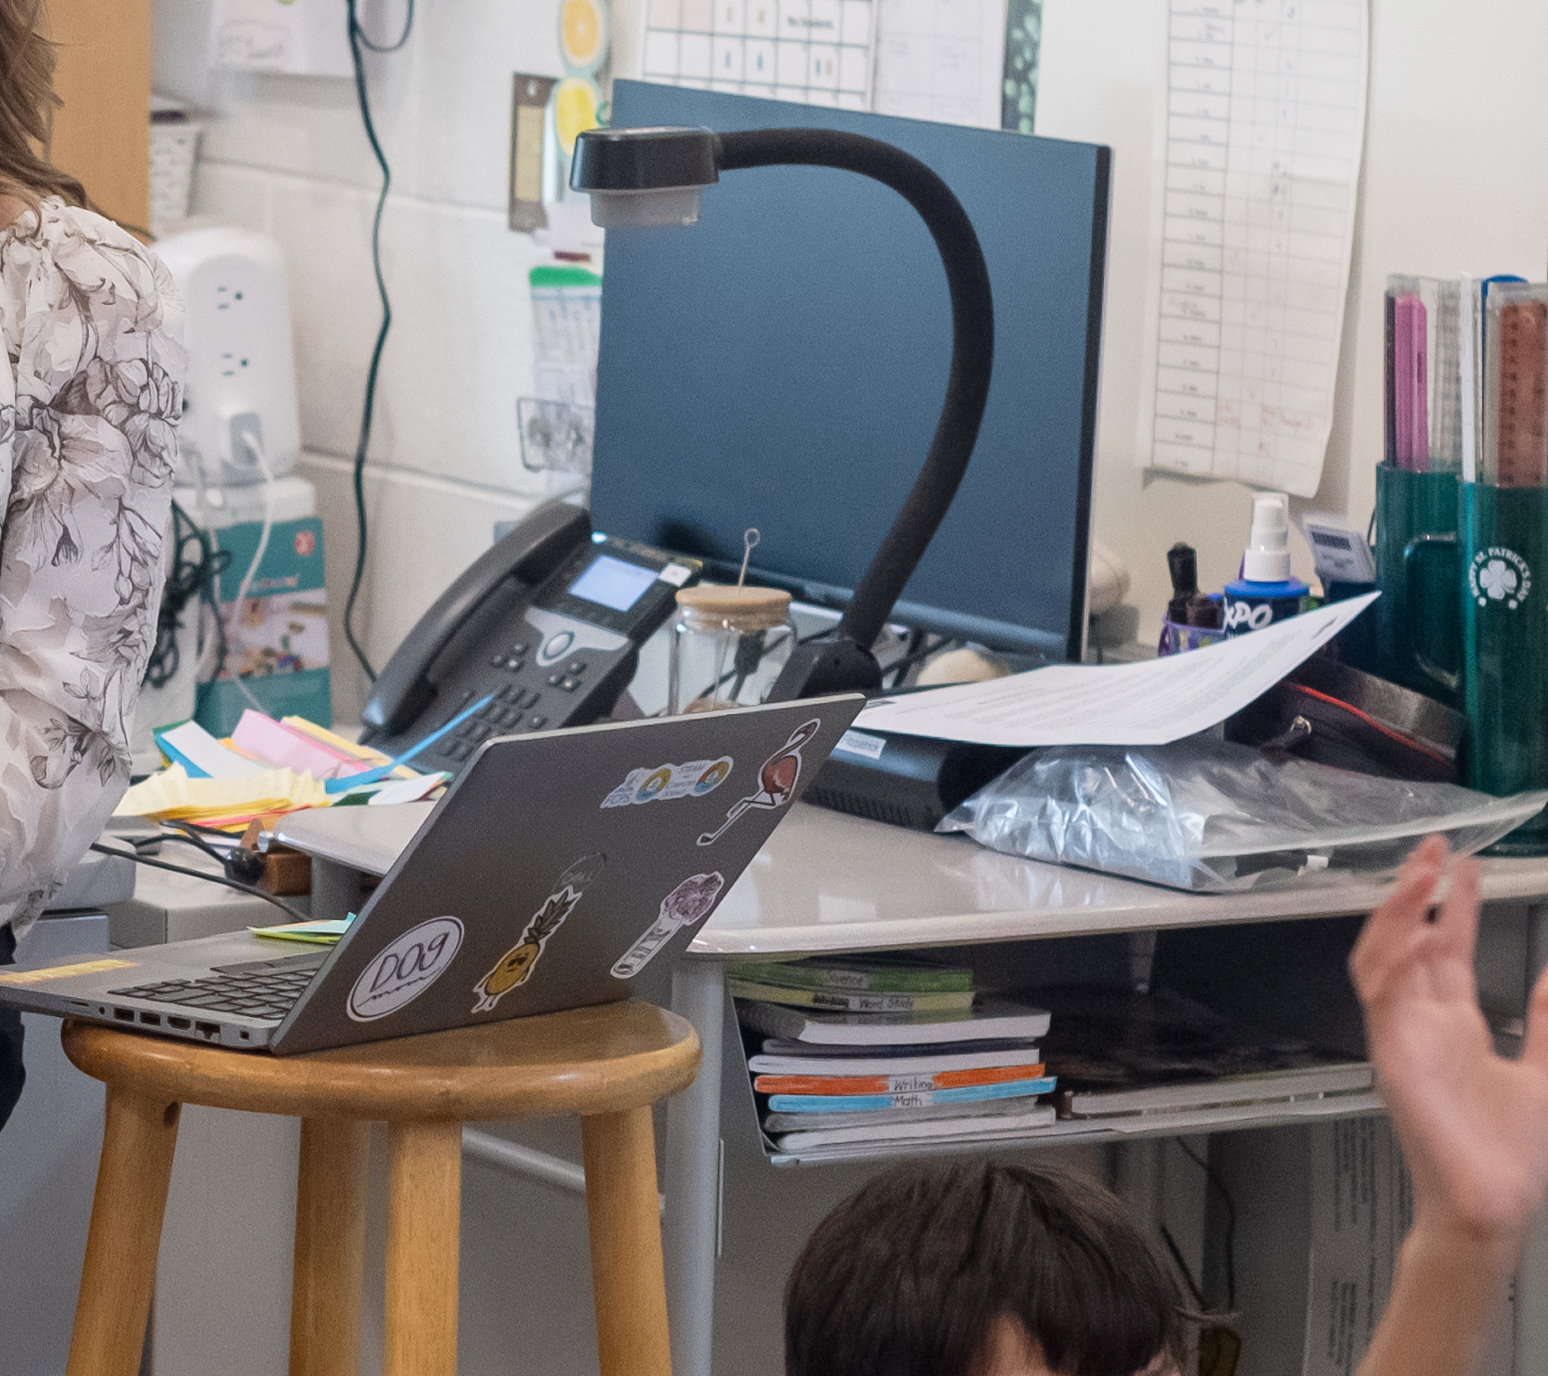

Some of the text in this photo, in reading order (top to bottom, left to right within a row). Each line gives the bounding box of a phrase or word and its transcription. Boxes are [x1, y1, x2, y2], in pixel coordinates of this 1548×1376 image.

[858, 995, 885, 1011] Word
[894, 1076, 933, 1093] Writing
[893, 1093, 923, 1109] Math
